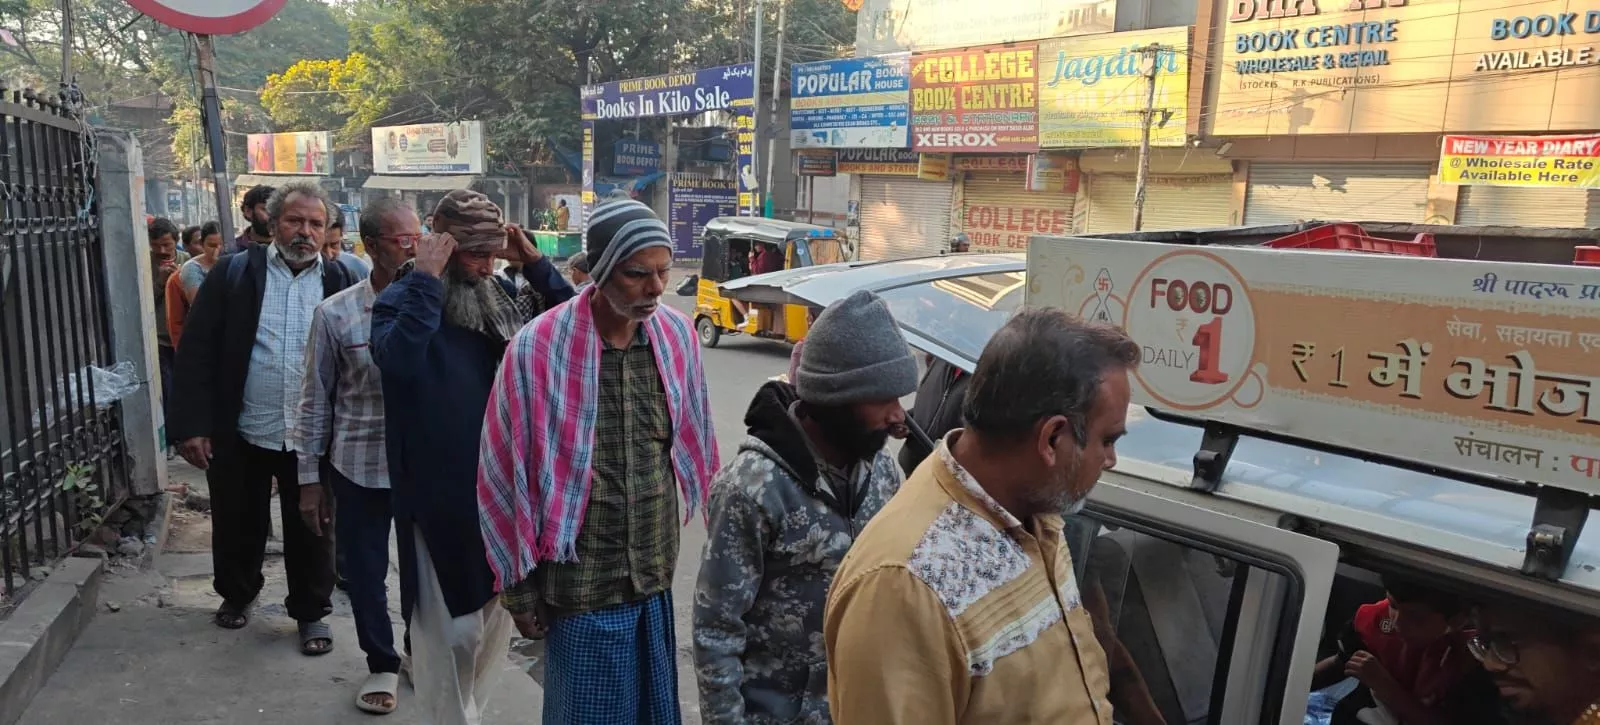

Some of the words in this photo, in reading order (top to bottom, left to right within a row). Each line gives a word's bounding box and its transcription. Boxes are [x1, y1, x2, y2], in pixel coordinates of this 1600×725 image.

[1236, 29, 1299, 53] BOOK
[1304, 19, 1399, 48] CENTRE
[1492, 14, 1577, 40] BOOK
[925, 50, 1034, 83] COLLEGE
[1237, 55, 1320, 74] WHOLESALE
[1323, 53, 1335, 69] &
[1339, 51, 1391, 68] RETAIL
[1475, 47, 1592, 71] AVAILABLE
[619, 81, 643, 92] PRIME
[645, 78, 667, 90] BOOK
[669, 73, 696, 87] DEPOT
[797, 69, 872, 95] POPULAR
[876, 66, 904, 78] BOOK
[874, 79, 903, 90] HOUSE
[597, 97, 635, 118] Books
[638, 94, 654, 115] In
[658, 91, 691, 113] Kilo
[913, 87, 956, 111] BOOK
[962, 83, 1035, 109] CENTRE
[916, 133, 997, 146] XEROX
[1452, 139, 1489, 154] NEW
[1493, 140, 1538, 154] YEAR
[1543, 140, 1598, 155] DIARY
[839, 146, 898, 161] POPULAR
[960, 158, 1027, 169] COLLEGE
[1466, 158, 1547, 168] Wholesale
[1554, 158, 1593, 170] Rate
[1459, 169, 1532, 181] Available
[1538, 172, 1578, 182] Here
[967, 204, 1067, 235] COLLEGE
[1150, 278, 1233, 315] FOOD
[1472, 272, 1498, 293] श्री
[1578, 284, 1600, 300] प्र
[1495, 325, 1573, 348] सहायता
[1143, 346, 1194, 370] DAILY
[1328, 346, 1348, 388] 1
[1367, 338, 1432, 400] में
[1454, 431, 1543, 468] संचालन
